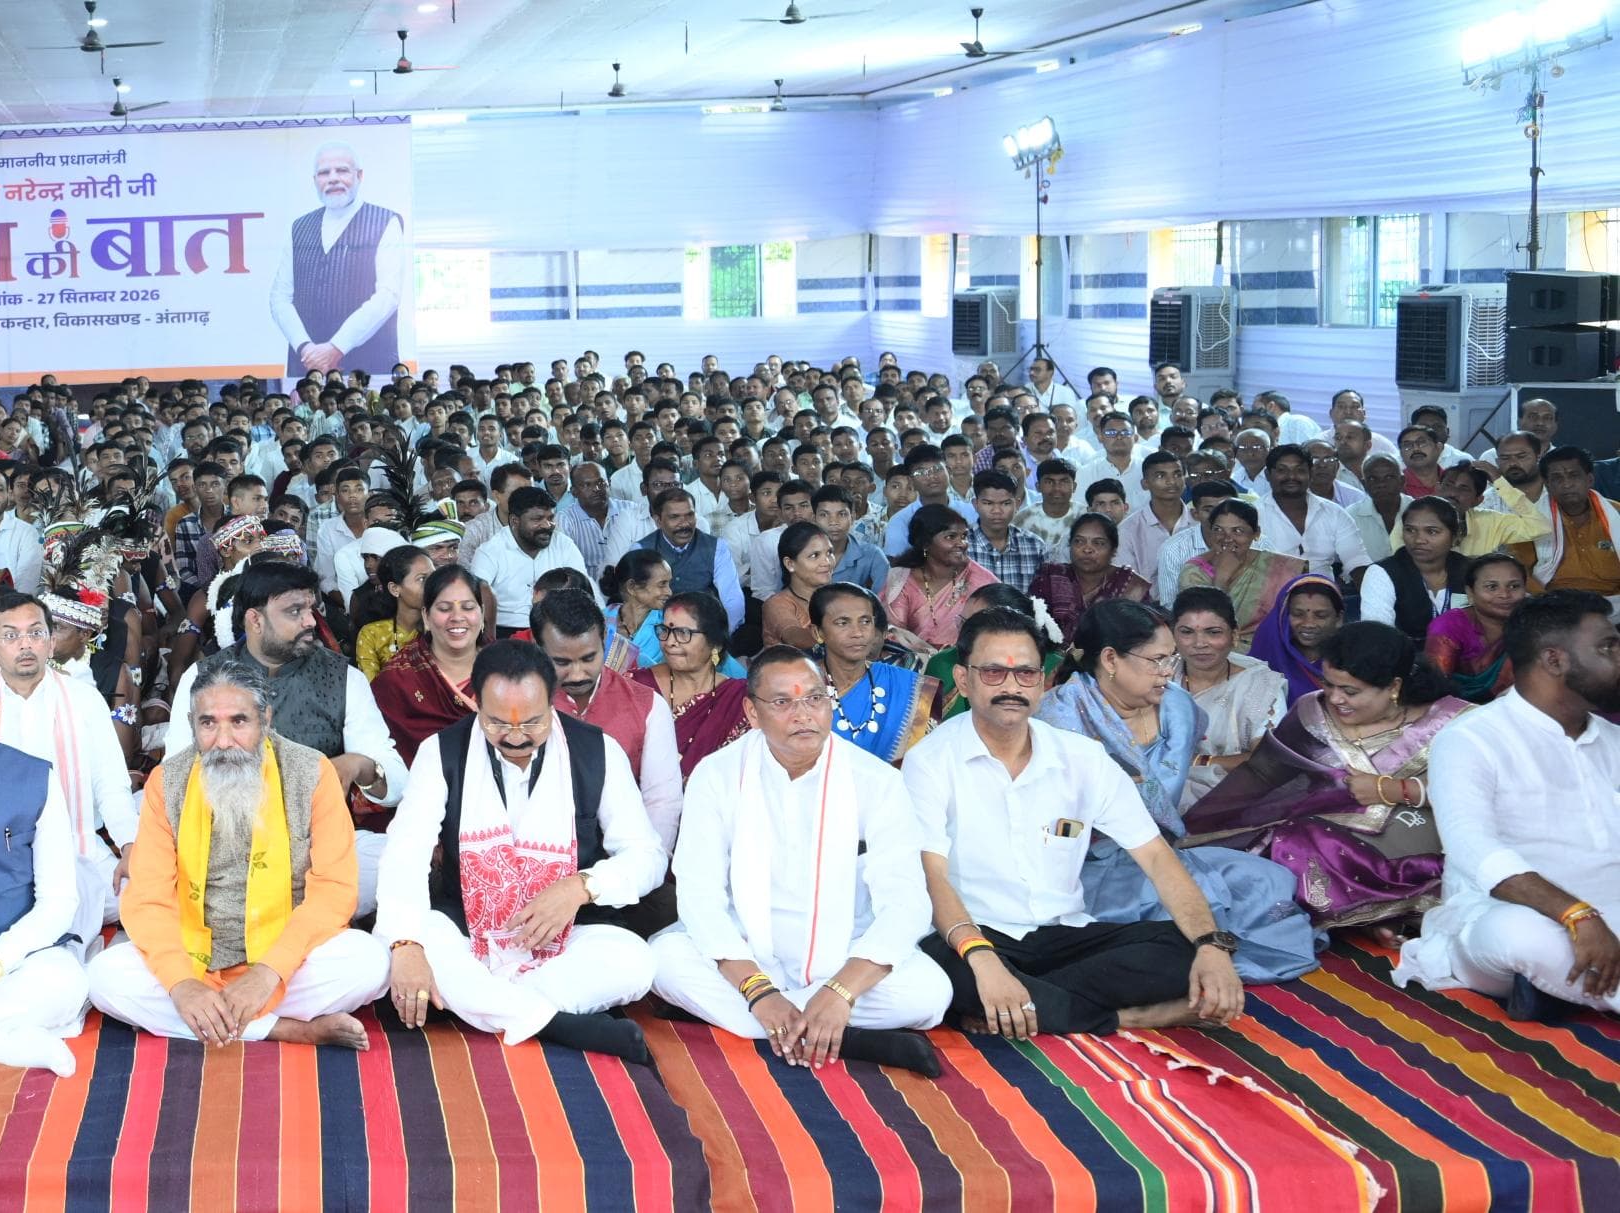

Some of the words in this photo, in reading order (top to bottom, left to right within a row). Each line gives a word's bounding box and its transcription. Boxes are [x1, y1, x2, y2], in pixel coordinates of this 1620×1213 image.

[59, 149, 127, 167] प्रधानमंत्री
[2, 177, 65, 202] नरेन्द्र
[69, 174, 122, 199] मोदी
[127, 172, 157, 197] जी
[26, 238, 80, 280] की
[86, 212, 264, 277] बात
[37, 292, 55, 305] 27
[59, 288, 117, 304] सितम्बर
[120, 289, 160, 302] 2026
